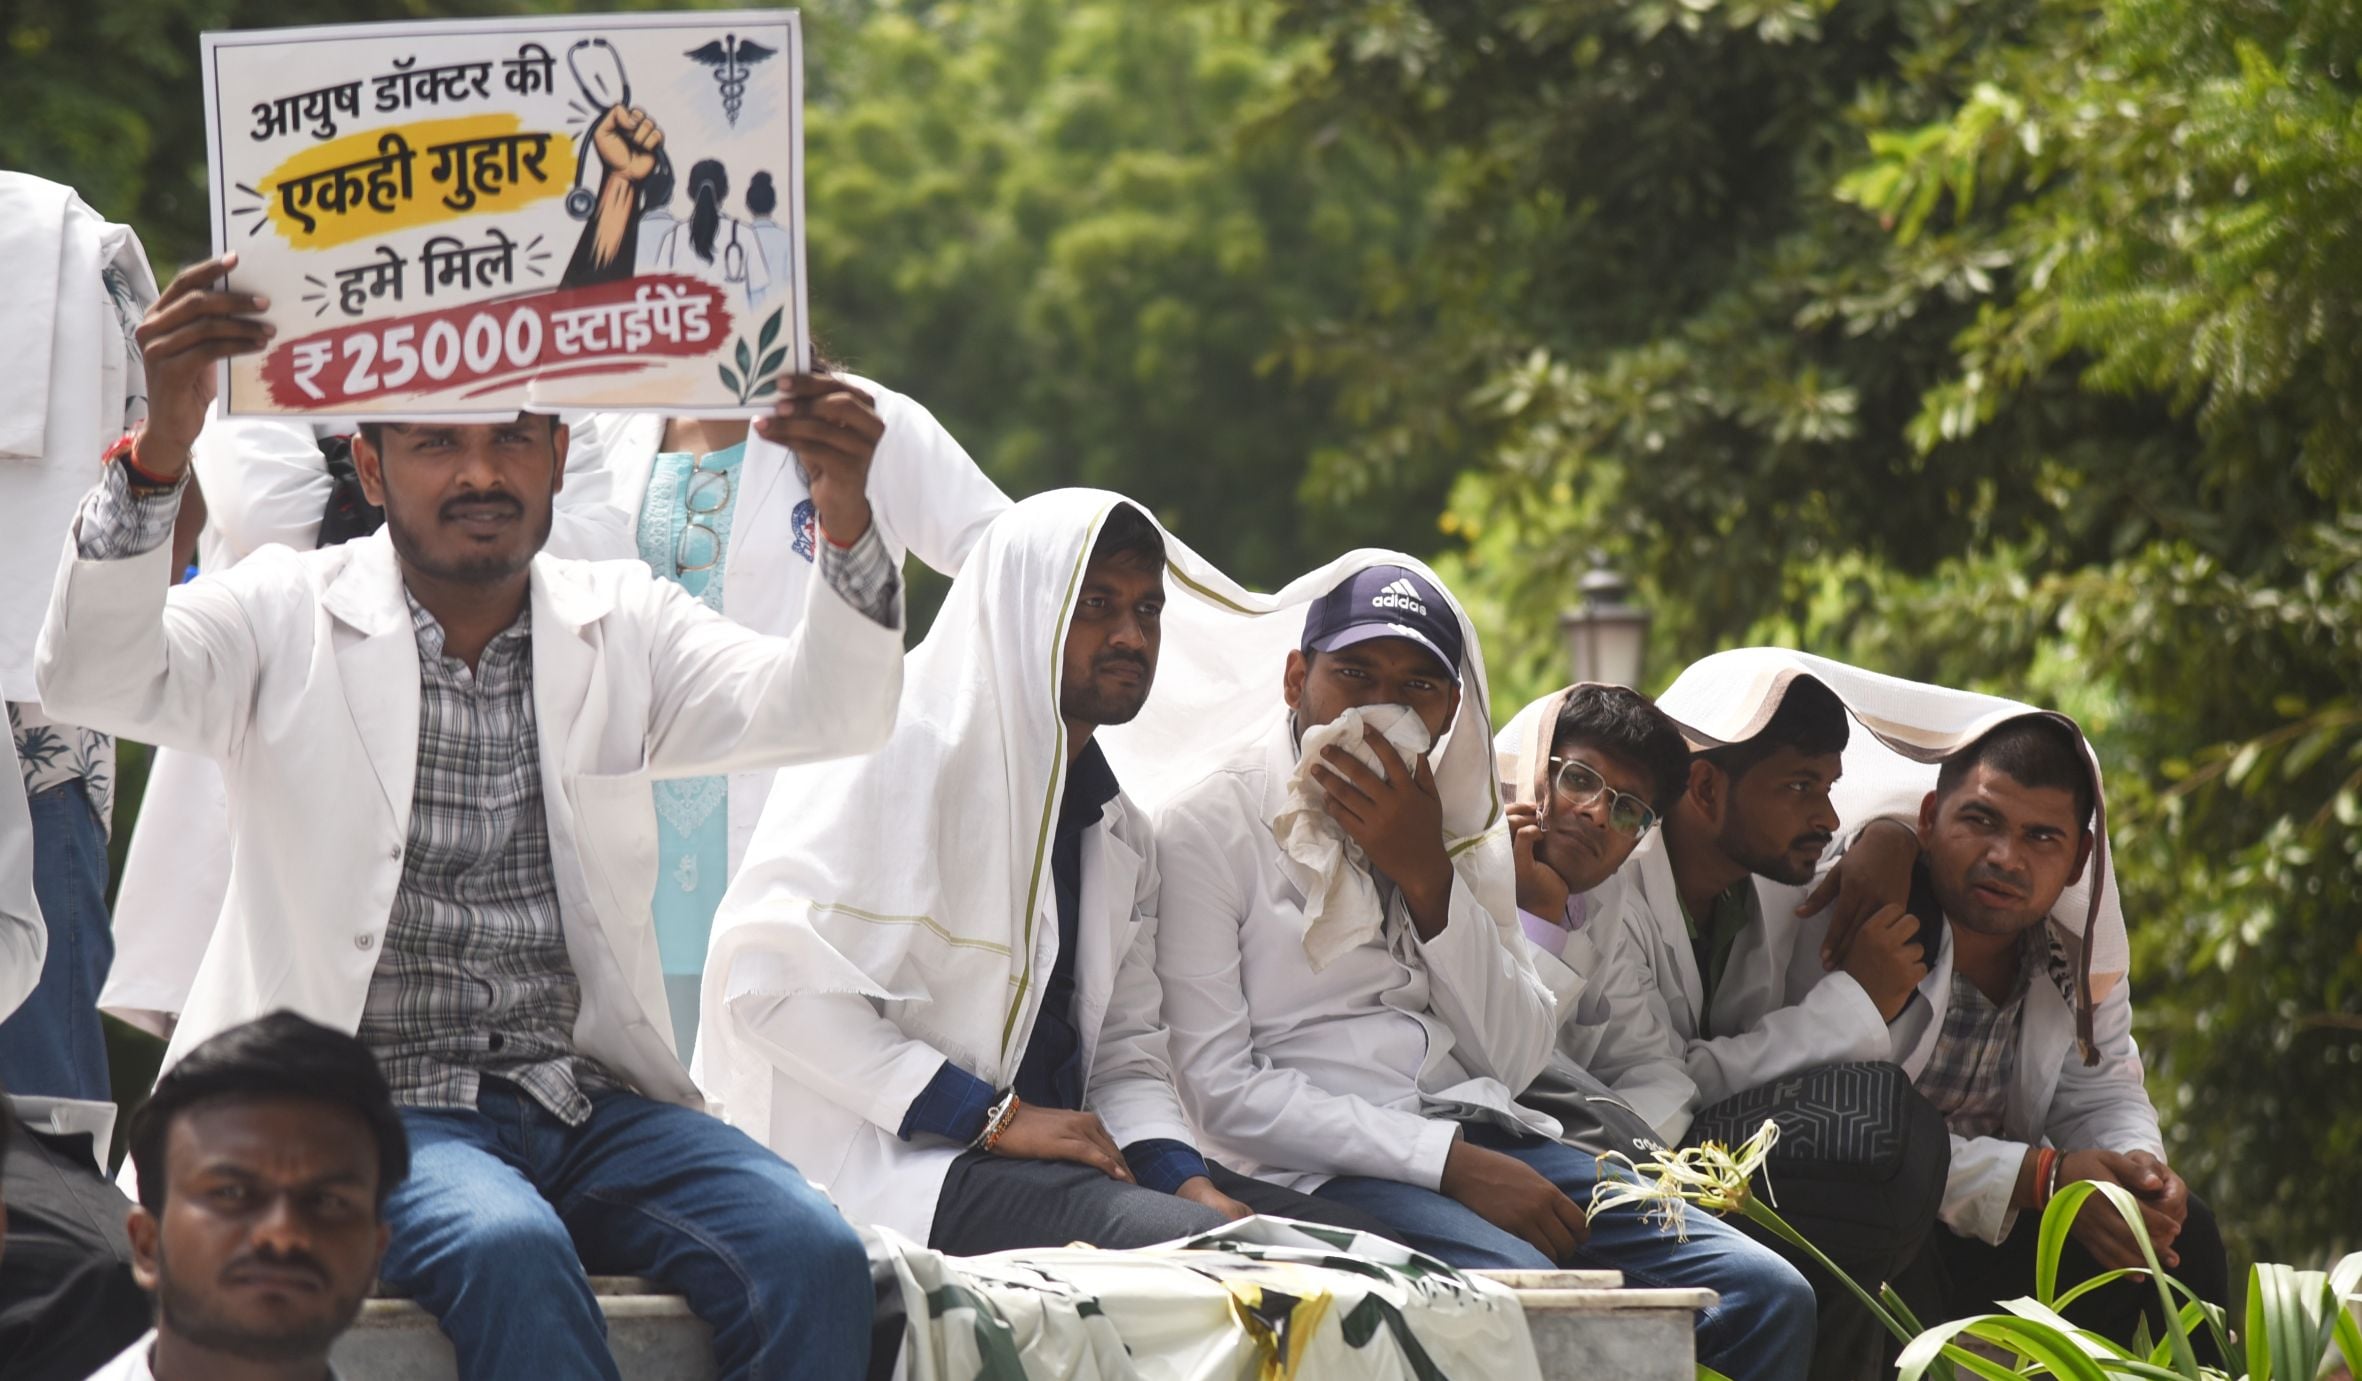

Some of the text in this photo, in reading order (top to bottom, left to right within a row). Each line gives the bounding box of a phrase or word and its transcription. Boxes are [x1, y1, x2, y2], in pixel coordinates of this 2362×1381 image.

[250, 43, 557, 140] आयुष डॉक्टर की
[277, 132, 552, 233] एकही गुहार
[335, 228, 517, 315] हमे मिले
[342, 306, 543, 395] 25000
[551, 284, 711, 354] स्टाईपेंड
[1372, 594, 1427, 616] adidas
